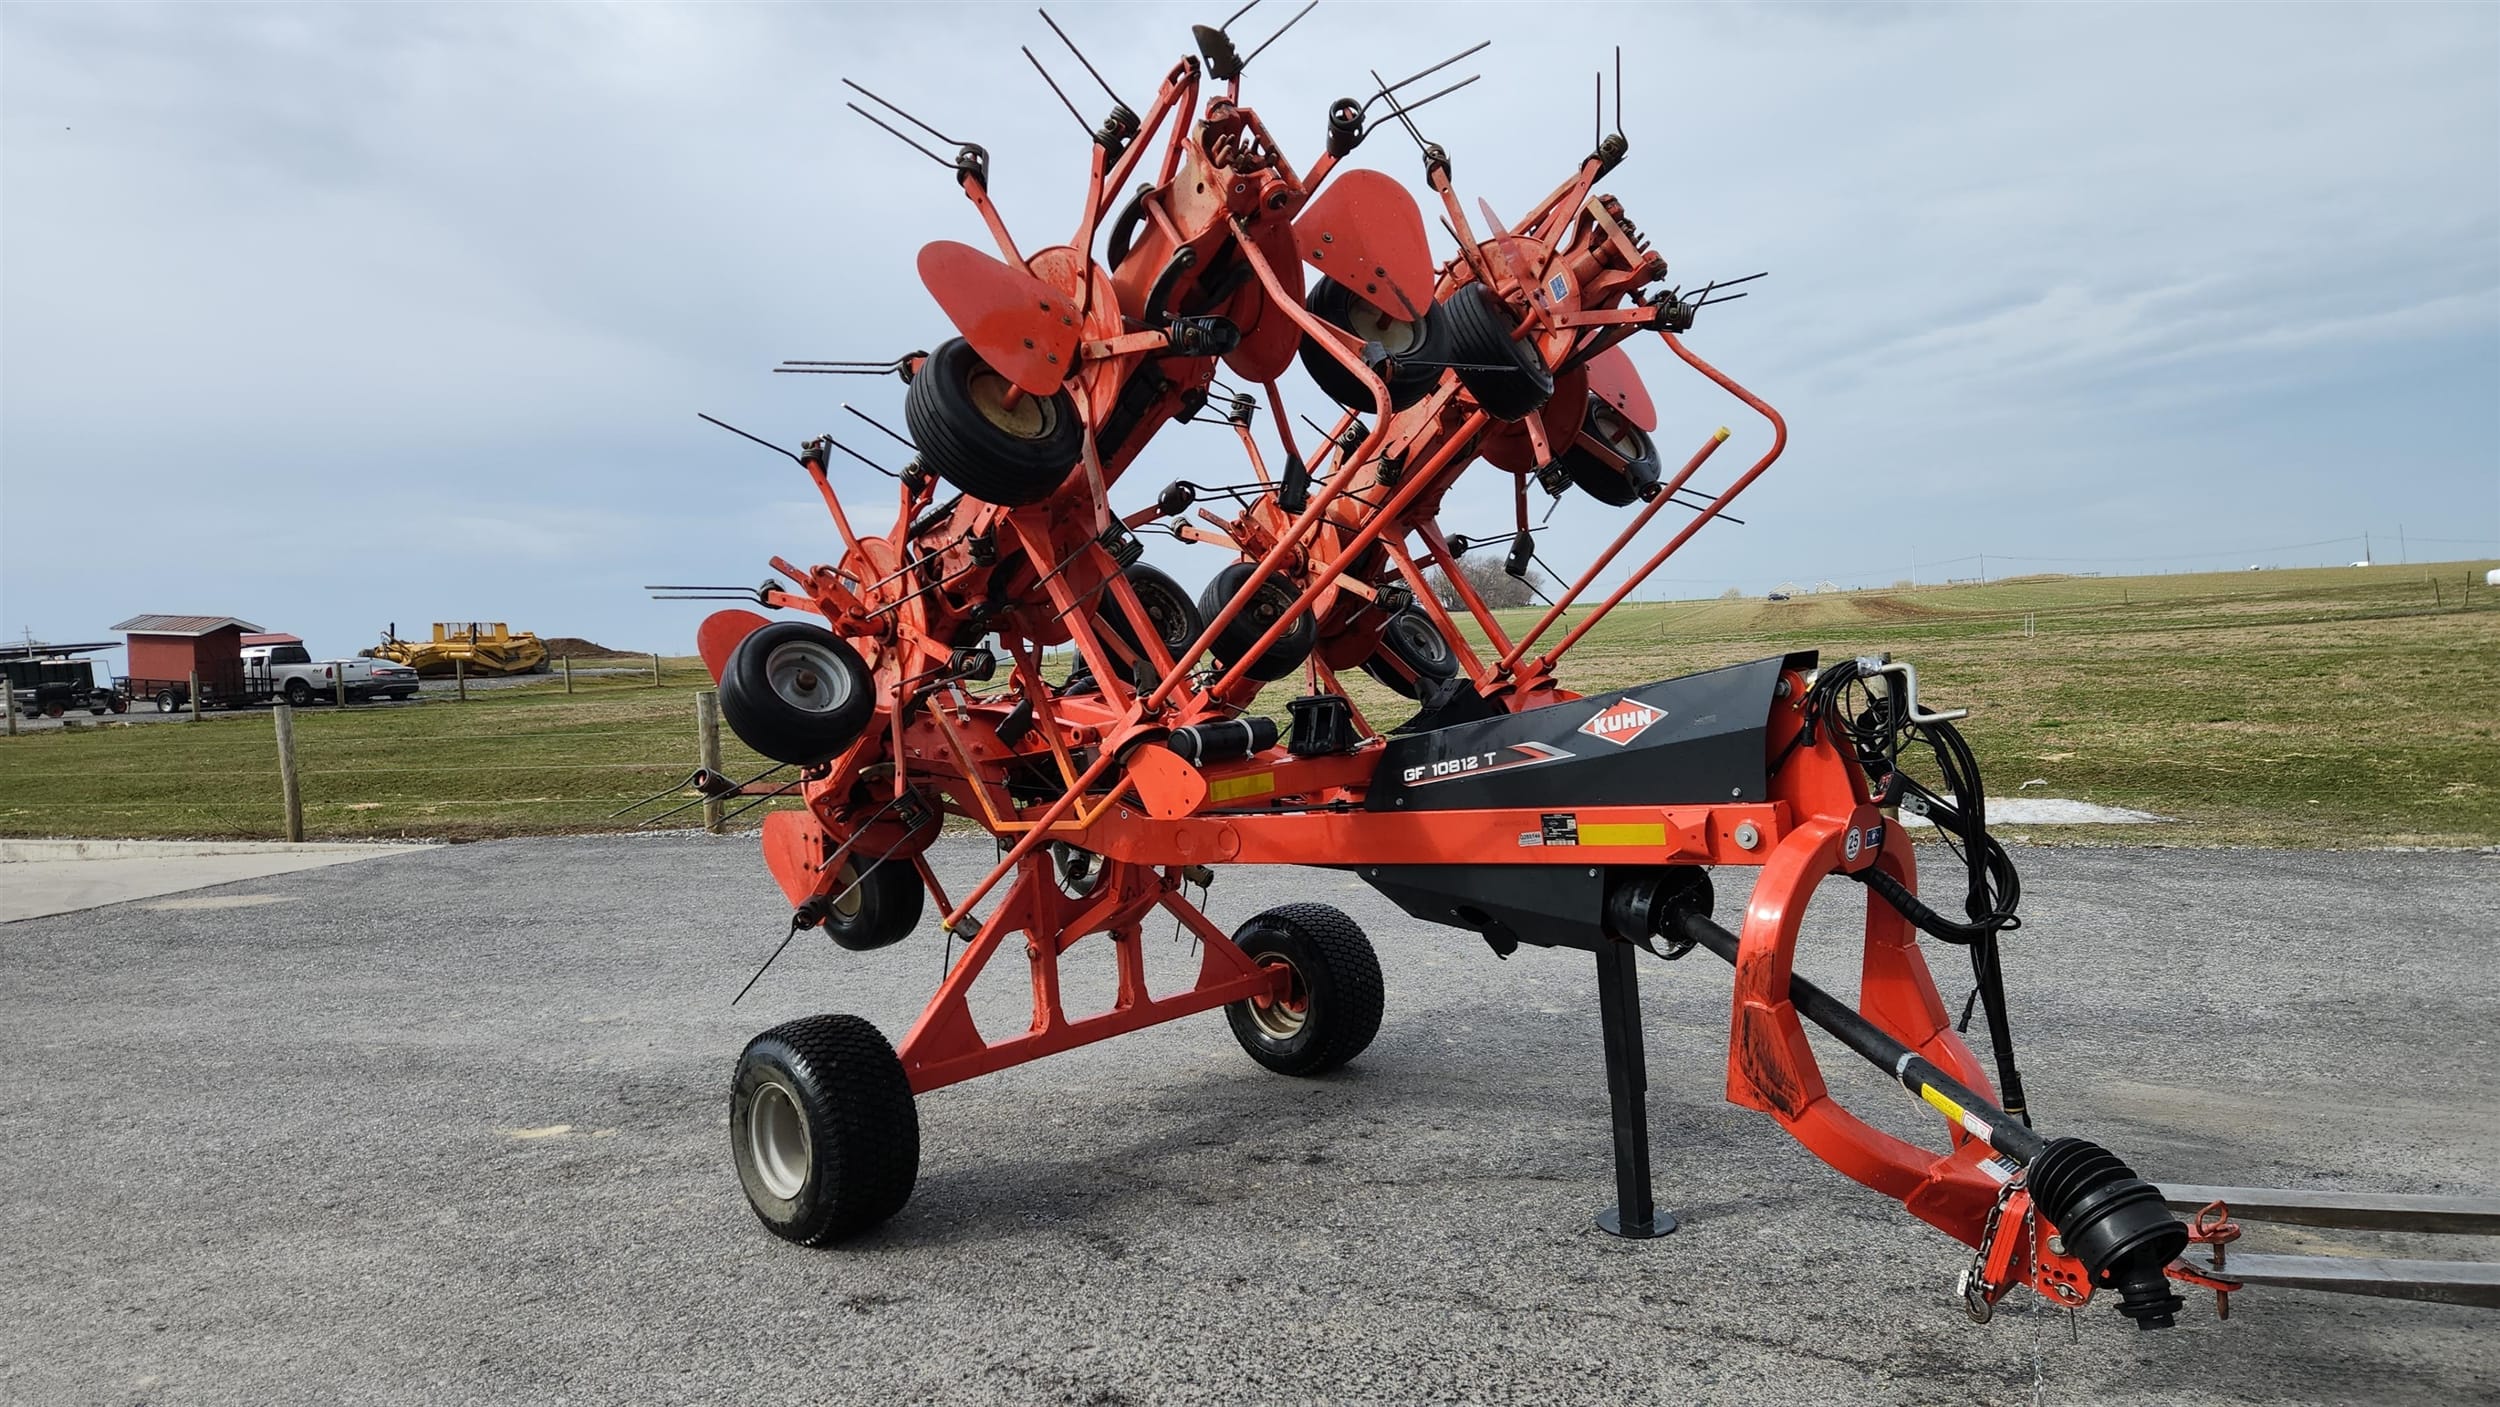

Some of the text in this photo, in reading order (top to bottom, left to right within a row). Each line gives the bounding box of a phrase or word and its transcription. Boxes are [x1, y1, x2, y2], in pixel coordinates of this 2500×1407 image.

[1593, 708, 1652, 735] KUHN
[1403, 752, 1496, 782] GF 10812 T
[1848, 834, 1859, 850] 25
